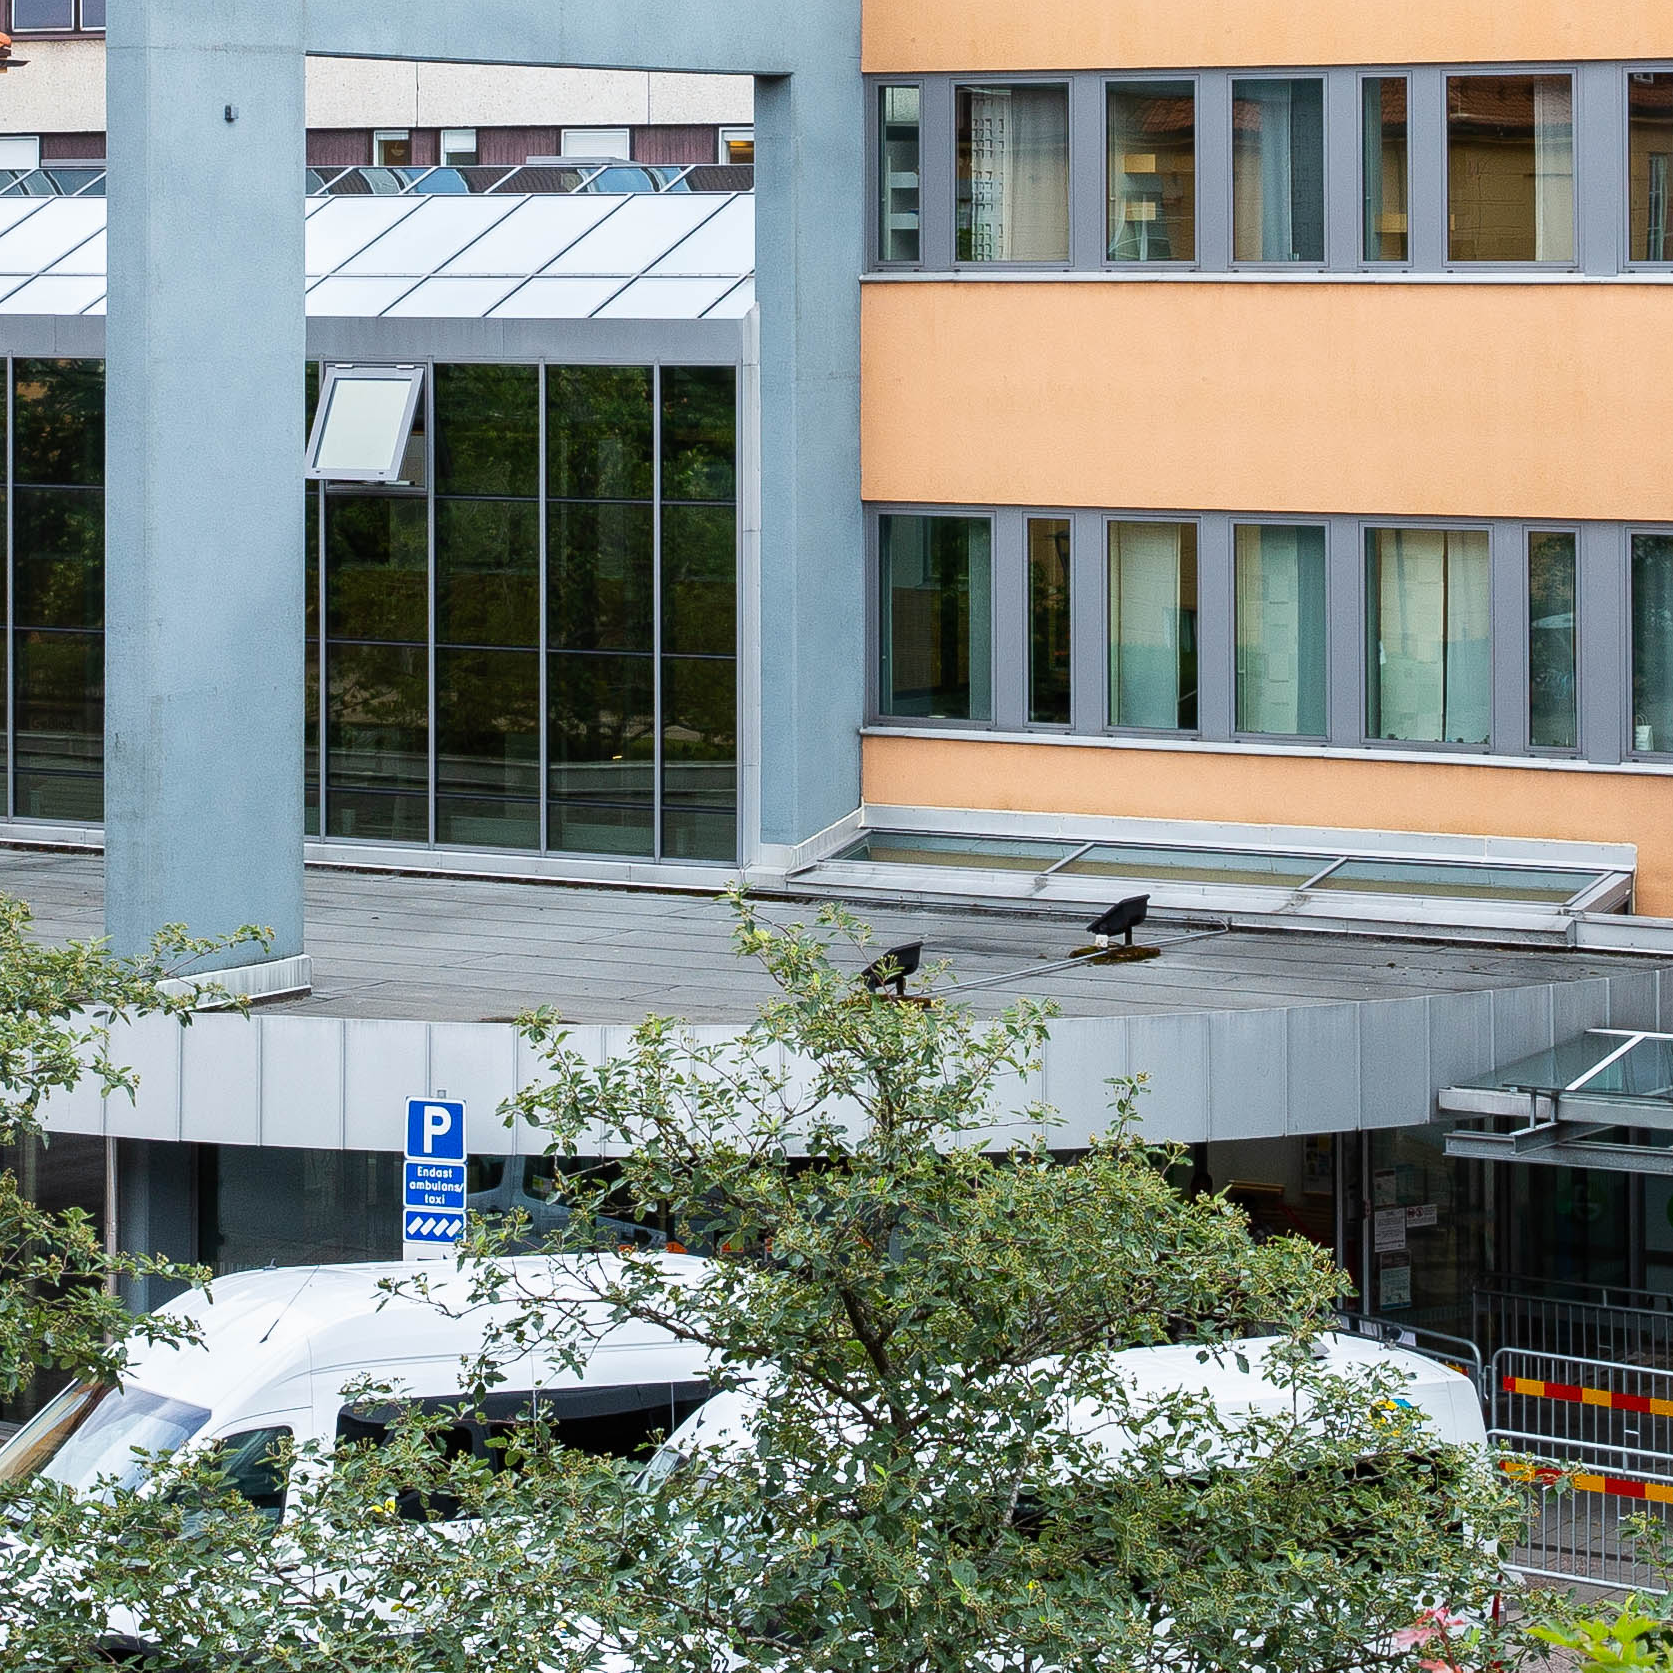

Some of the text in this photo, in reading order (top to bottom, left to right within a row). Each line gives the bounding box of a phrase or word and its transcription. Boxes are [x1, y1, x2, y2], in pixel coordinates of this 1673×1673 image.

[423, 1105, 452, 1155] P
[417, 1166, 453, 1179] Endast
[409, 1179, 464, 1193] ambulans/
[424, 1193, 446, 1205] taxi
